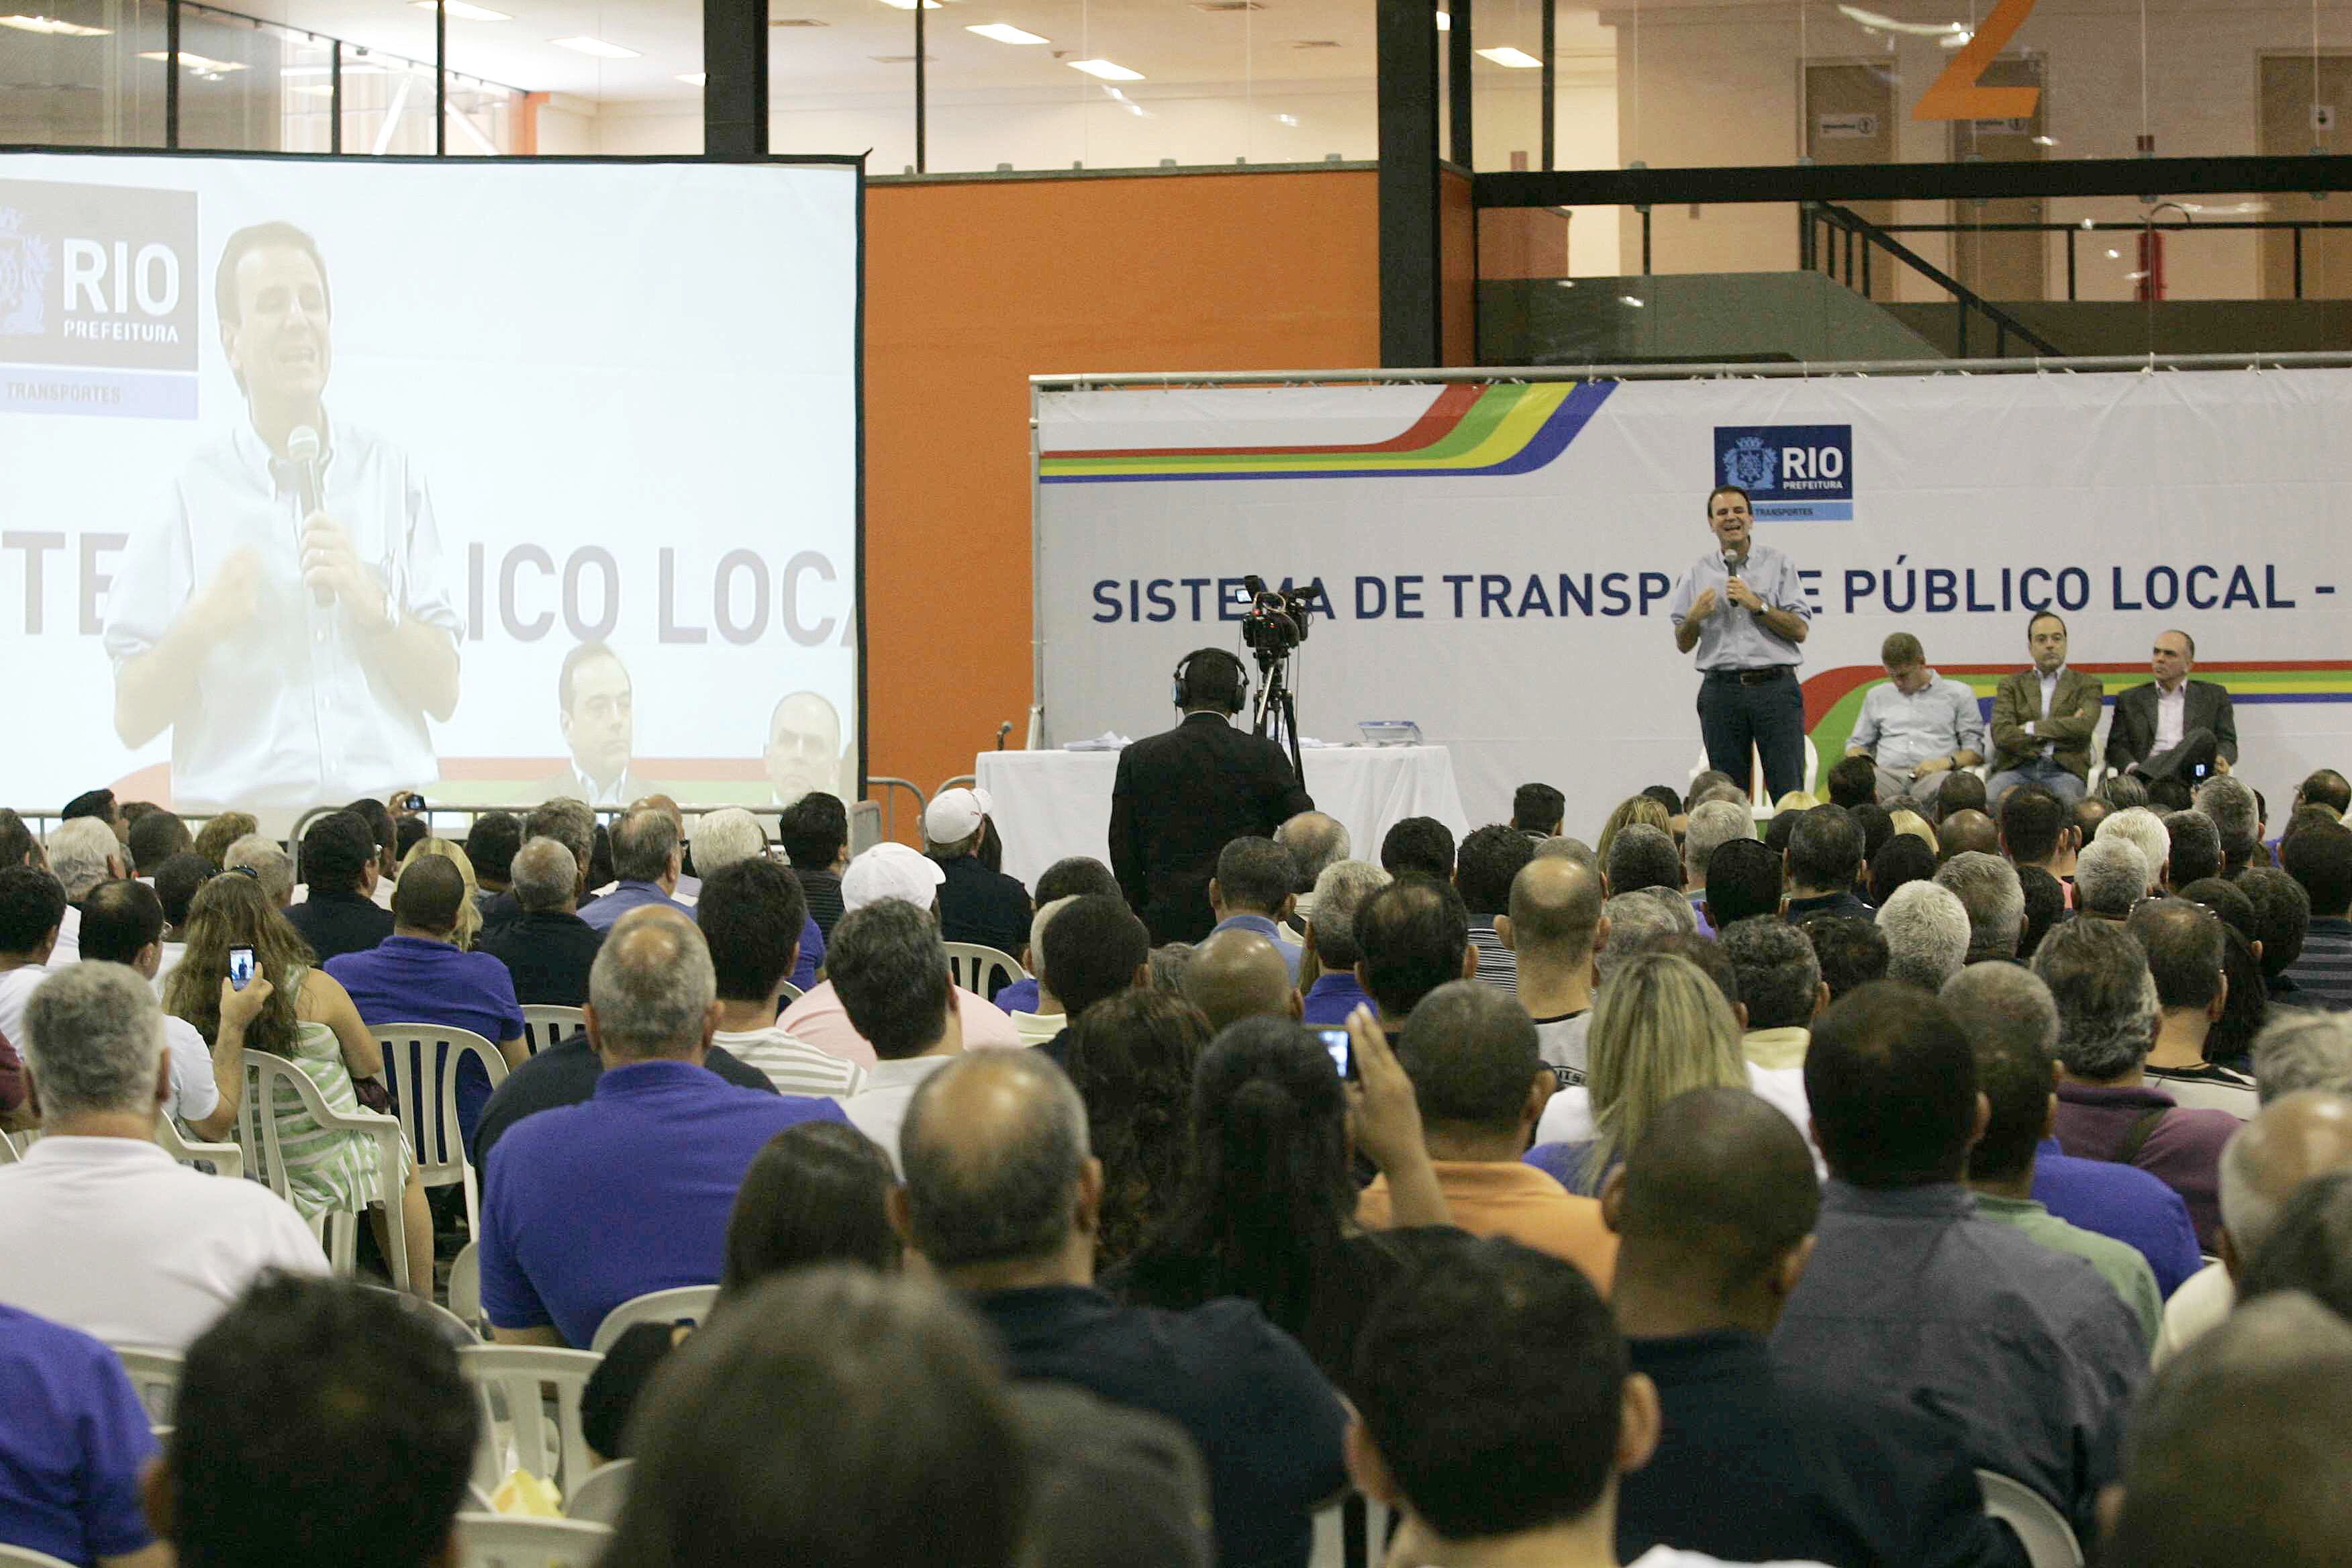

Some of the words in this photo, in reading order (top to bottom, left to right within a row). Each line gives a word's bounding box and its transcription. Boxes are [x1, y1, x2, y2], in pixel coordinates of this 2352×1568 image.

[64, 238, 179, 316] RIO
[64, 319, 179, 344] PREFEITURA
[7, 381, 121, 403] TRANSPORTES
[1782, 446, 1843, 479] RIO
[1783, 481, 1843, 489] PREFEITURA
[1755, 507, 1814, 516] TRANSPORTES
[658, 546, 856, 648] LOC
[1355, 576, 1424, 620] DE
[1845, 554, 2090, 614] PÚBLICO
[2112, 564, 2296, 611] LOCAL
